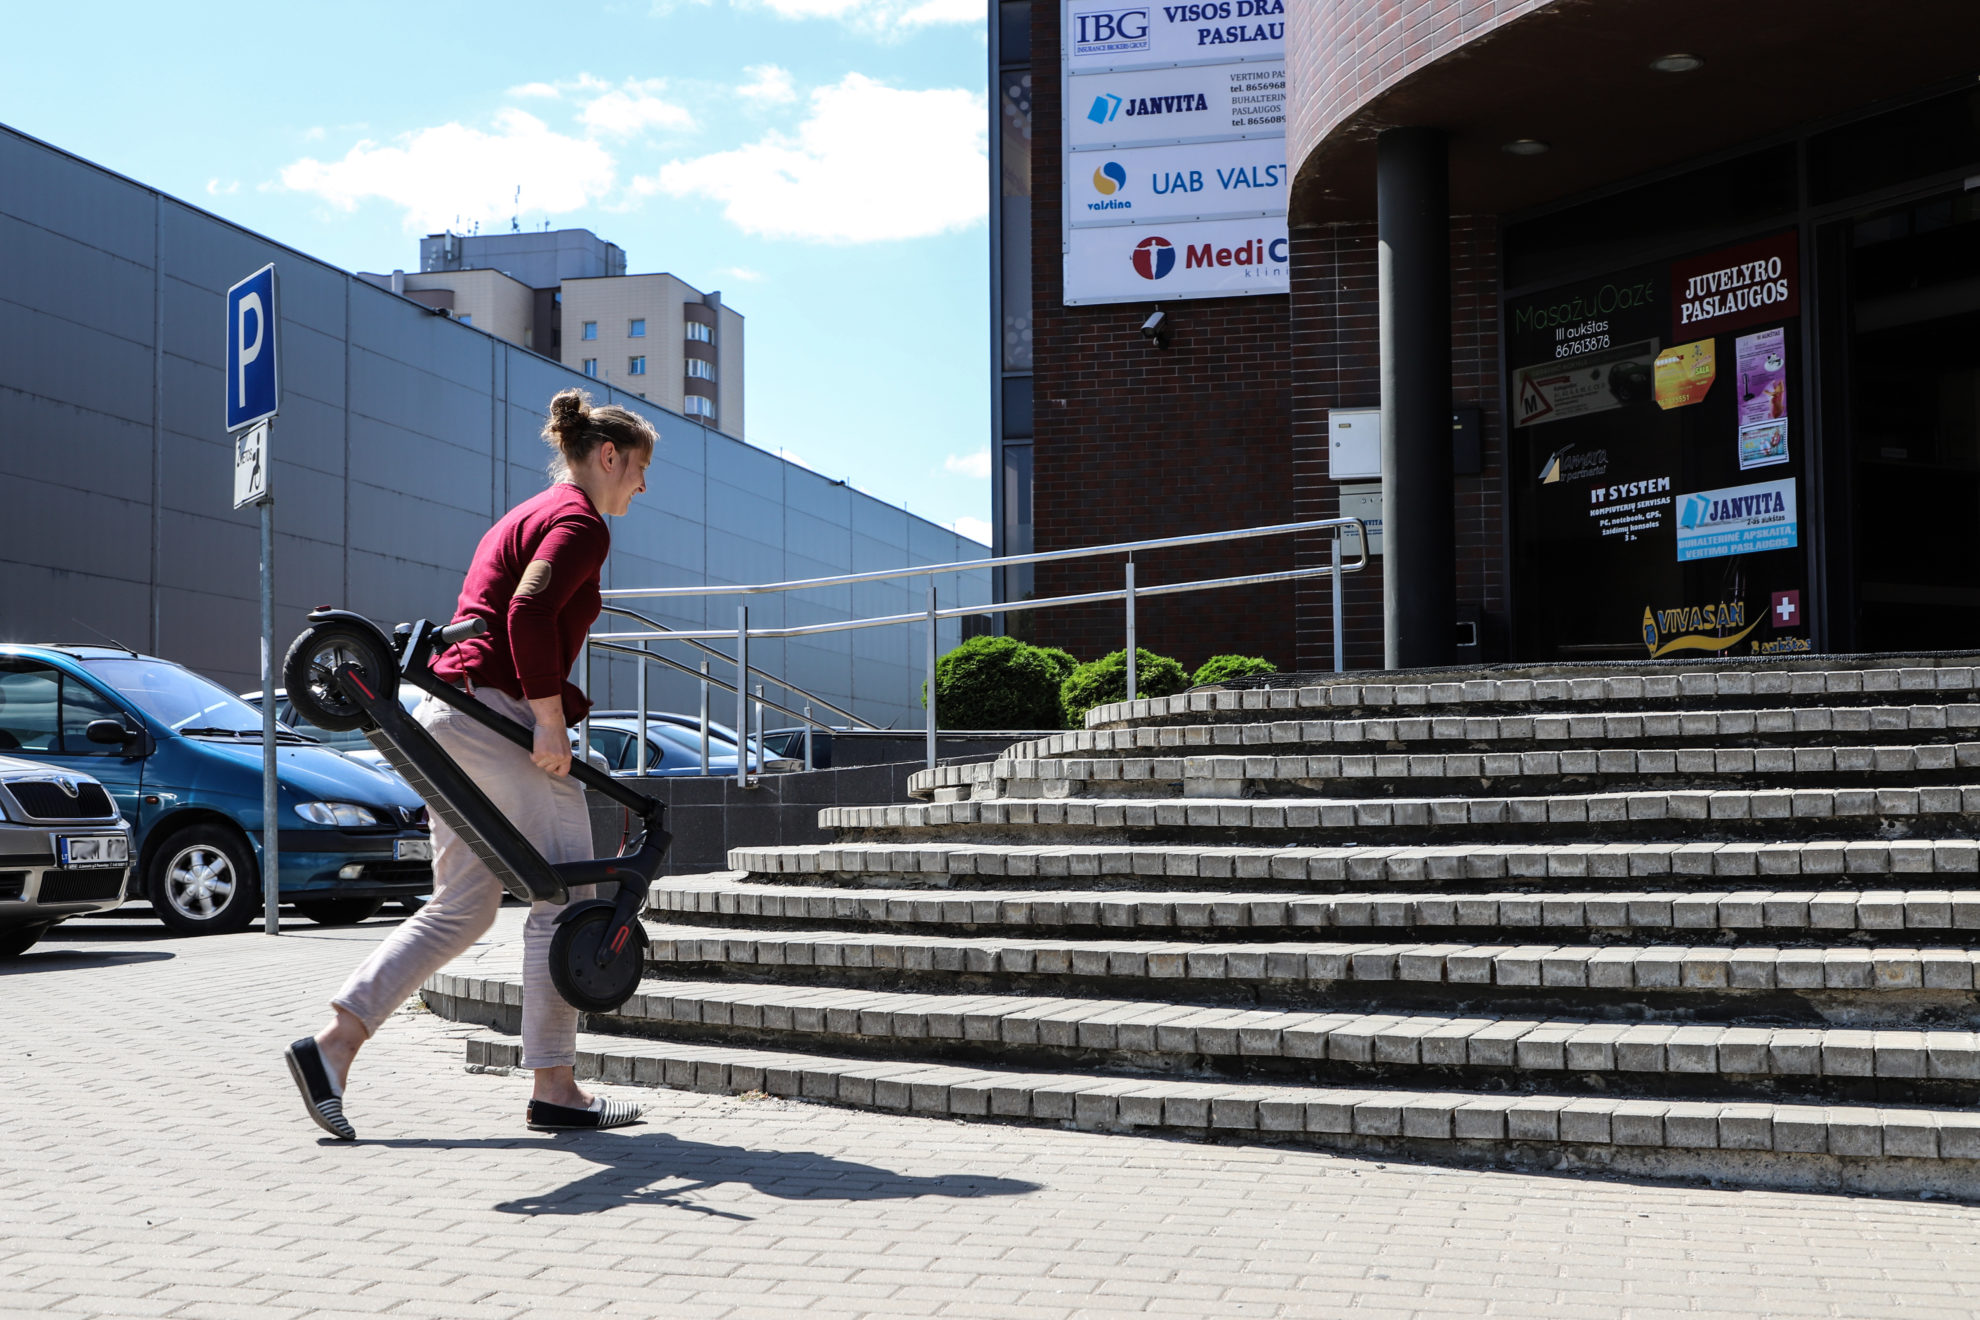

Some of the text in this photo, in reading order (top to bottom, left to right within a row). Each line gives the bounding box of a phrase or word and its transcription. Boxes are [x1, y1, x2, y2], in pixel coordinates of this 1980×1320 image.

[1164, 1, 1231, 23] VISOS
[1076, 11, 1148, 43] IBG
[1198, 22, 1284, 46] PASLAU
[1077, 44, 1106, 53] INSURANCE
[1107, 43, 1129, 51] BROKERS
[1230, 72, 1270, 82] VERTIMO
[1230, 81, 1286, 92] tel. 8656968
[1126, 94, 1208, 116] JANVITA
[1232, 105, 1281, 116] PASLAUGOS
[1232, 118, 1246, 126] tel.
[1152, 170, 1204, 195] UAB
[1088, 199, 1132, 211] valstina
[1186, 238, 1288, 269] MediC
[1685, 256, 1782, 299] JUVELYRO
[1681, 279, 1788, 324] PASLAUGOS
[1556, 320, 1609, 341] III aukštas
[238, 292, 264, 408] P
[1555, 334, 1610, 358] 867613878
[1524, 395, 1538, 415] M
[1591, 476, 1670, 504] IT SYSTEM
[1636, 496, 1671, 509] SERVISAS
[1710, 491, 1785, 522] JANVITA
[1761, 514, 1786, 524] aukštas
[1678, 526, 1796, 549] BUHALTERINĖ APSKAITA,
[1686, 538, 1790, 559] VERTIMO PASLAUGOS
[1658, 601, 1744, 634] VIVASAN
[1762, 636, 1812, 654] aukštas
